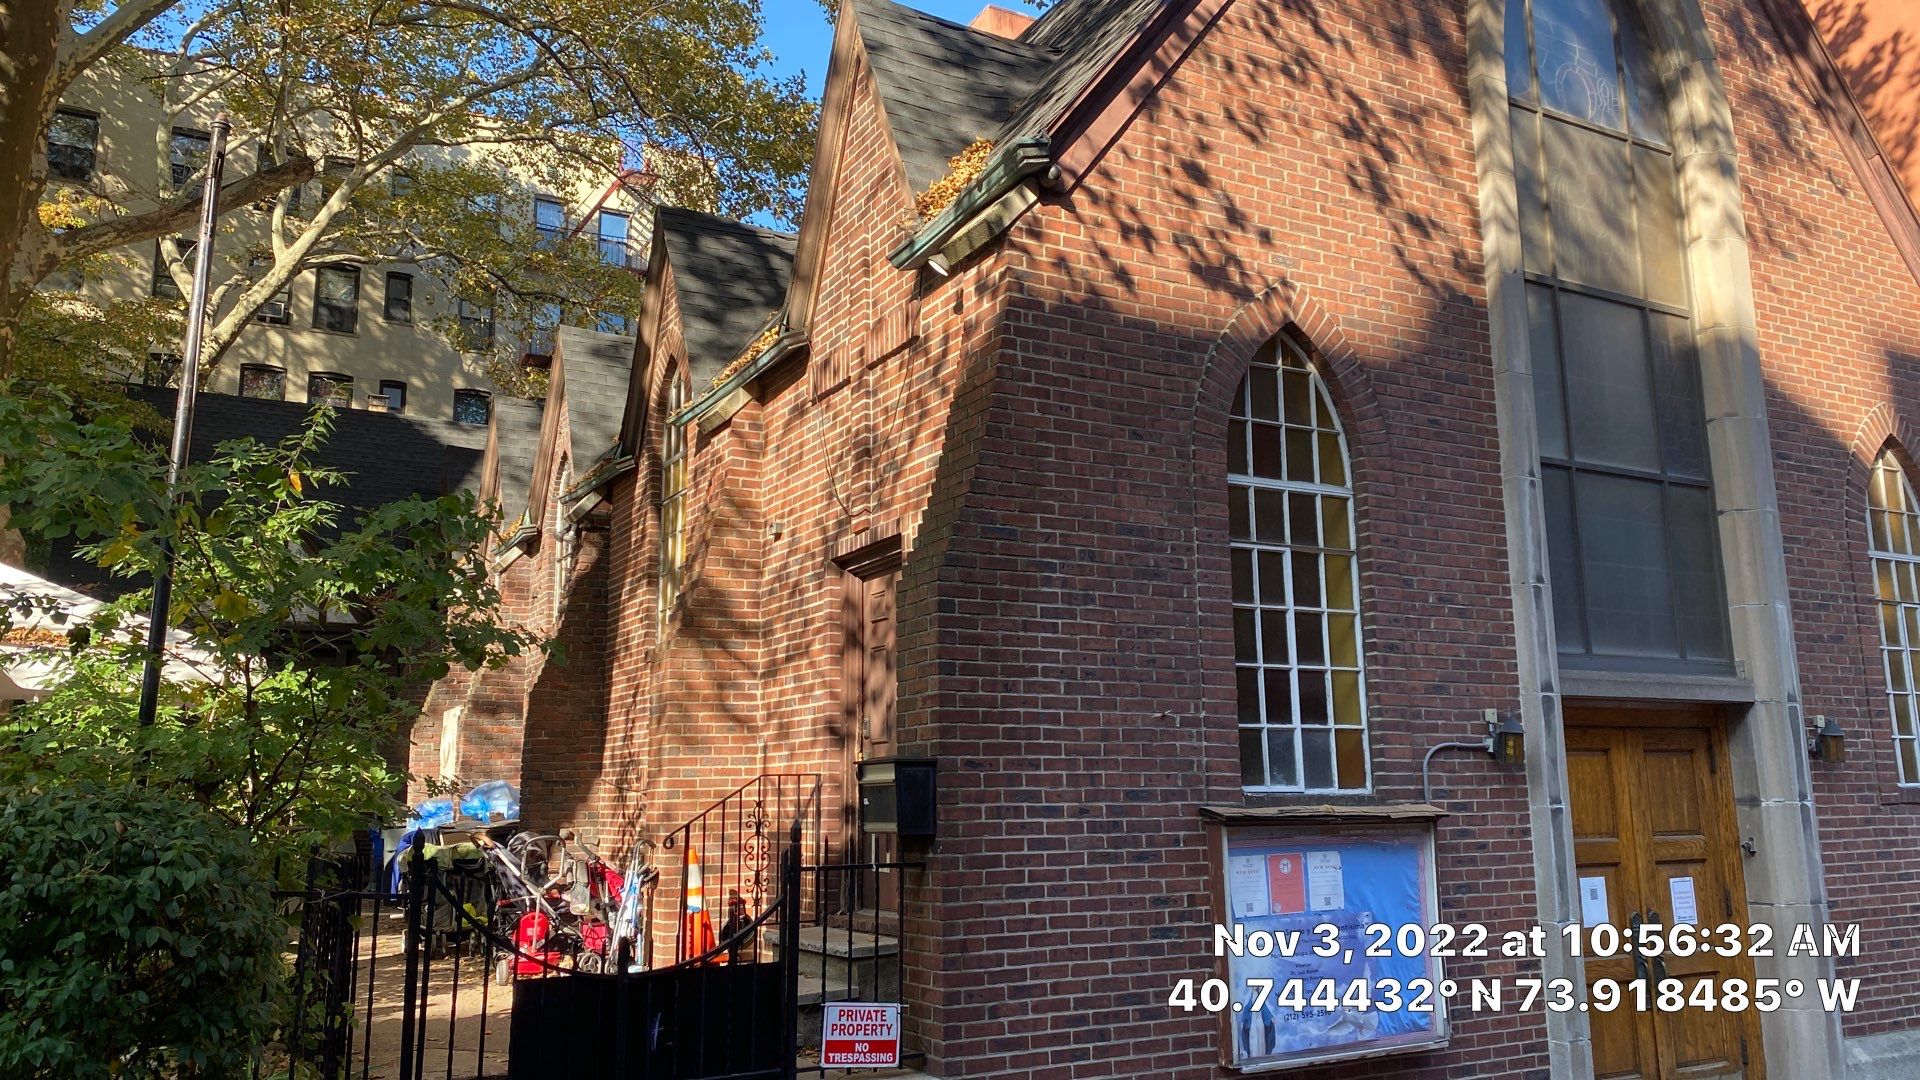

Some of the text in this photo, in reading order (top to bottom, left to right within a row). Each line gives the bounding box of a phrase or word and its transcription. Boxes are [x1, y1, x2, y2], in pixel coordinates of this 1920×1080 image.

[838, 1009, 887, 1022] PRIVATE
[831, 1023, 893, 1036] PROPERTY
[854, 1042, 870, 1053] NO
[828, 1053, 893, 1063] TRESPASSING
